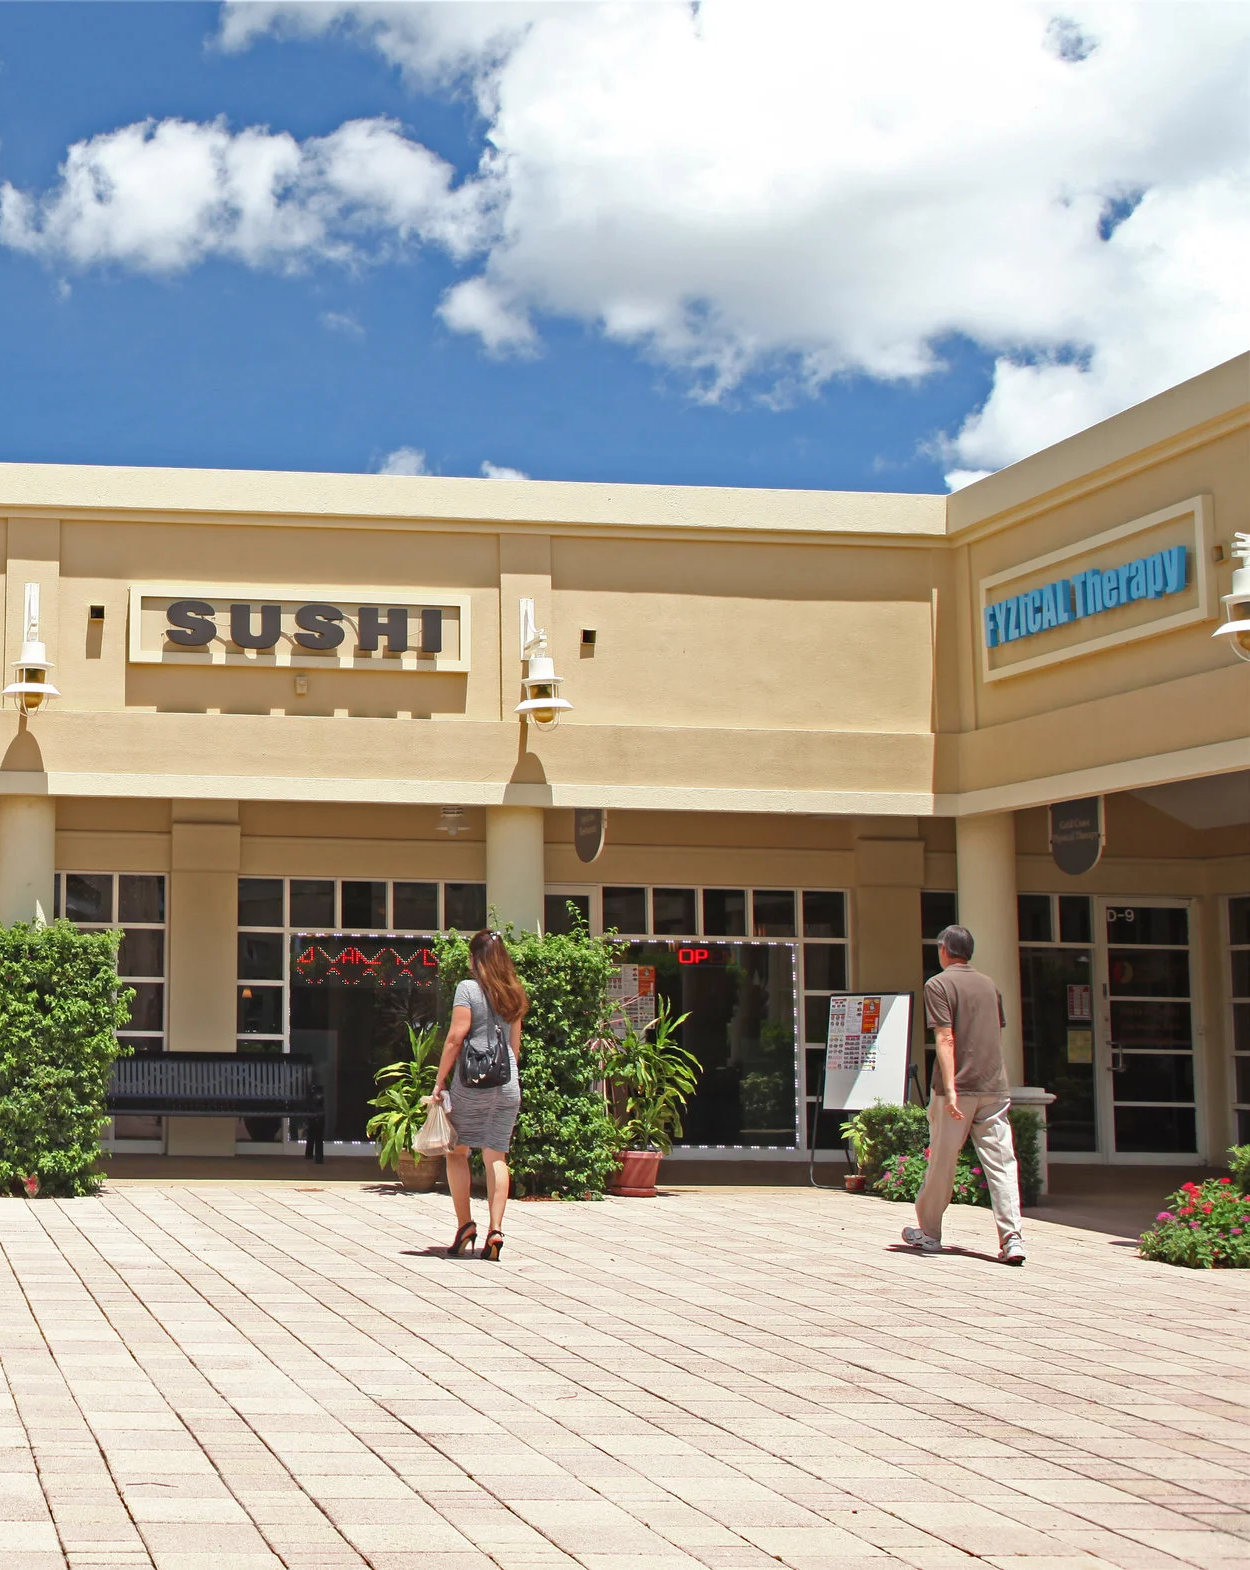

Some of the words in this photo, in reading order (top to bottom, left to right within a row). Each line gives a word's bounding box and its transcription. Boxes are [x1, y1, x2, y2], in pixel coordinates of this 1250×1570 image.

[1071, 545, 1187, 619] Therapy
[166, 600, 443, 653] SUSHI
[1107, 909, 1135, 922] D-9
